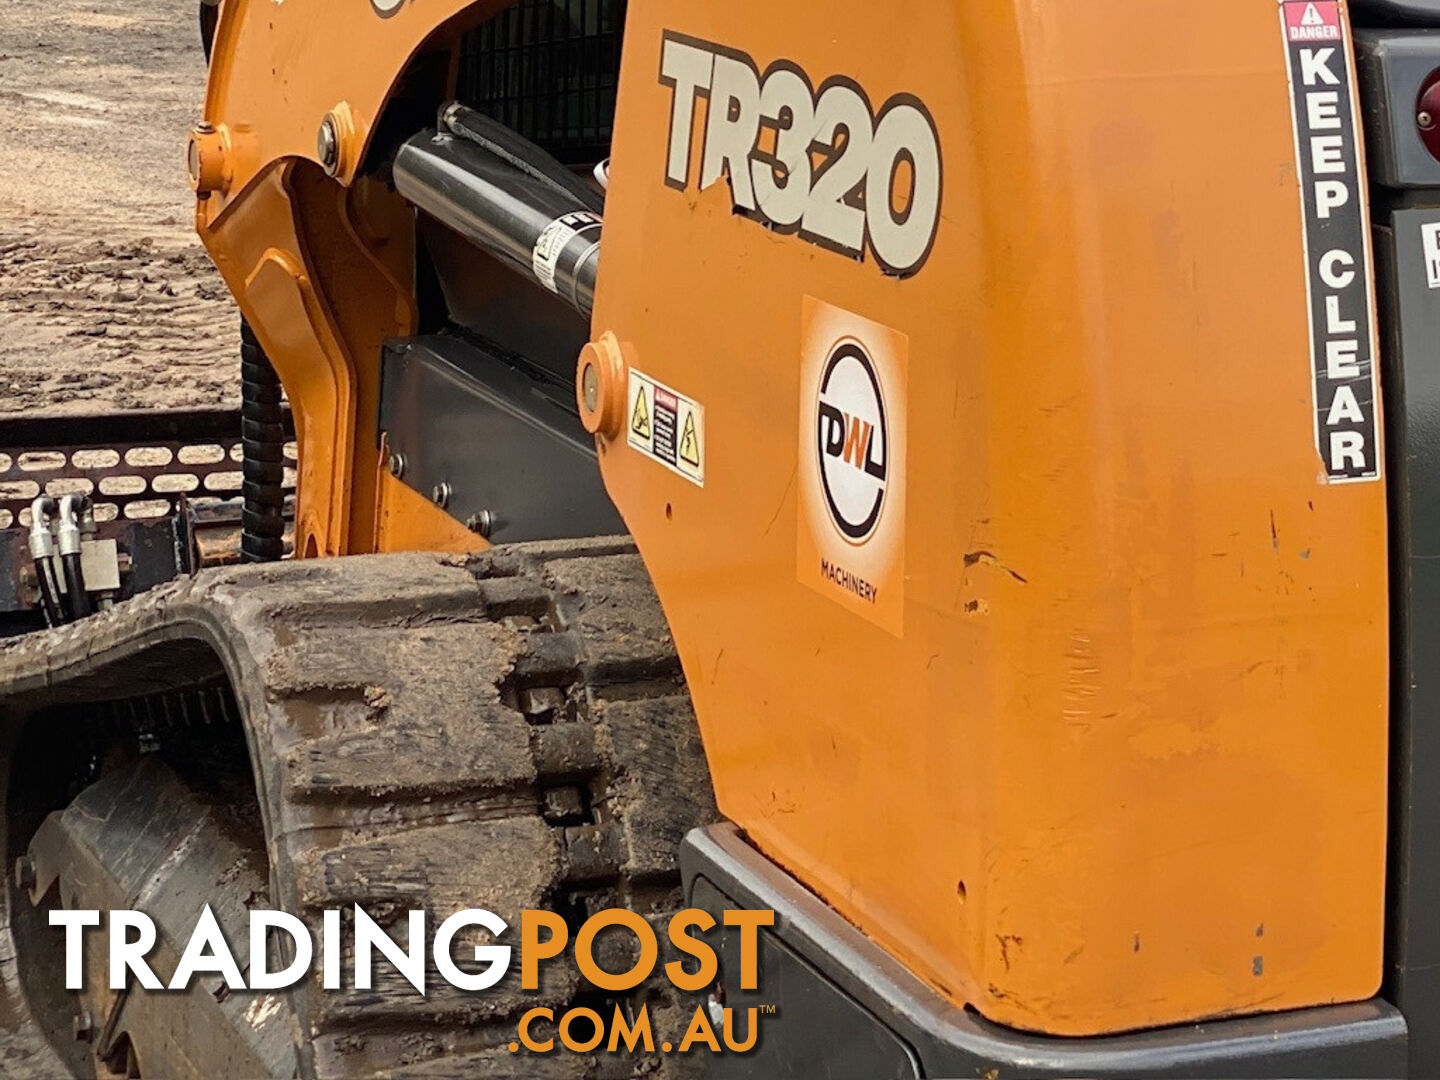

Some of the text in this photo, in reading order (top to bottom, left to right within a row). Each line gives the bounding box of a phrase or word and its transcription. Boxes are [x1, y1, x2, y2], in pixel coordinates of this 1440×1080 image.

[1290, 25, 1338, 40] DANGER
[658, 28, 943, 280] TR320
[1299, 47, 1367, 471] KEEP CLEAR
[818, 400, 886, 481] DWL
[820, 558, 877, 604] MACHINERY
